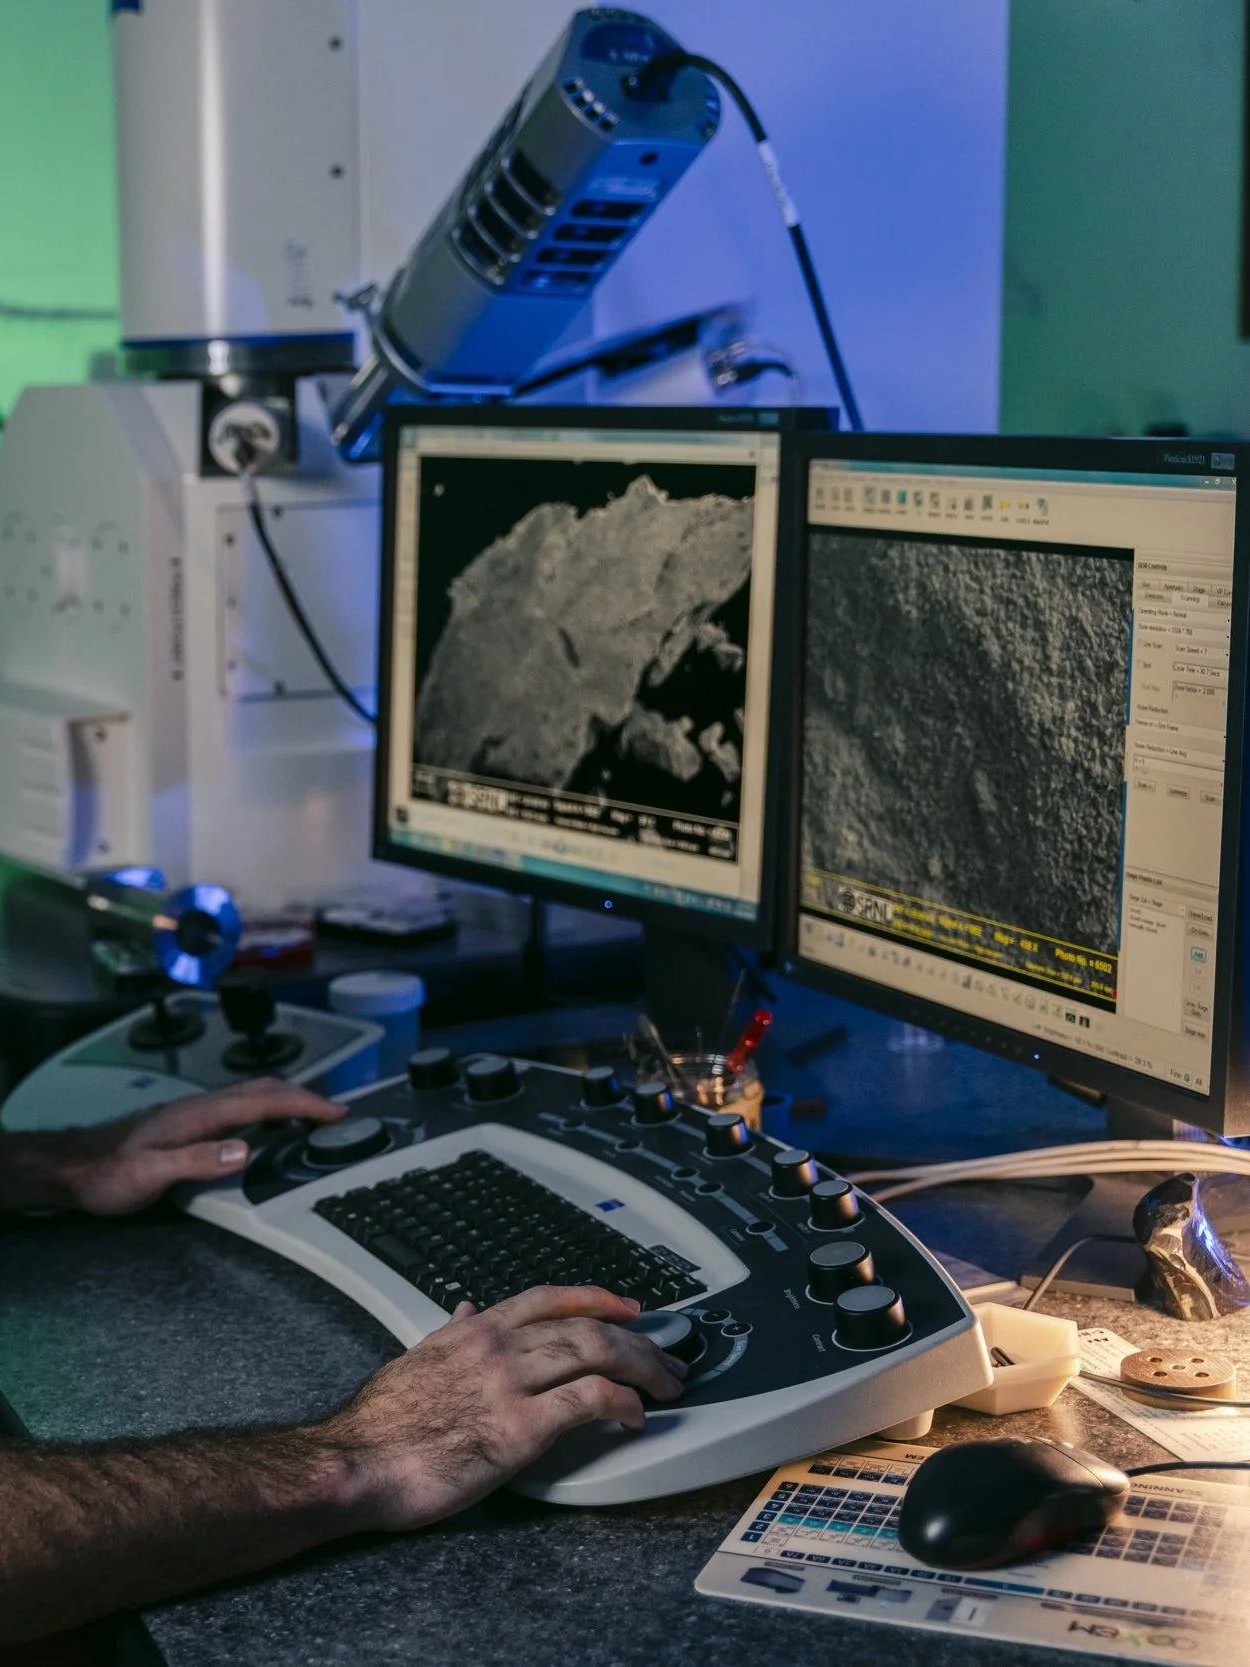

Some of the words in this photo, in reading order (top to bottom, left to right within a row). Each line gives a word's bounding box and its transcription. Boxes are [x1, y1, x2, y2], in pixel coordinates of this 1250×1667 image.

[1180, 594, 1200, 604] Scanning
[1055, 947, 1075, 962] Photo
[783, 1288, 801, 1311] Brightness
[811, 1333, 827, 1353] Contrast
